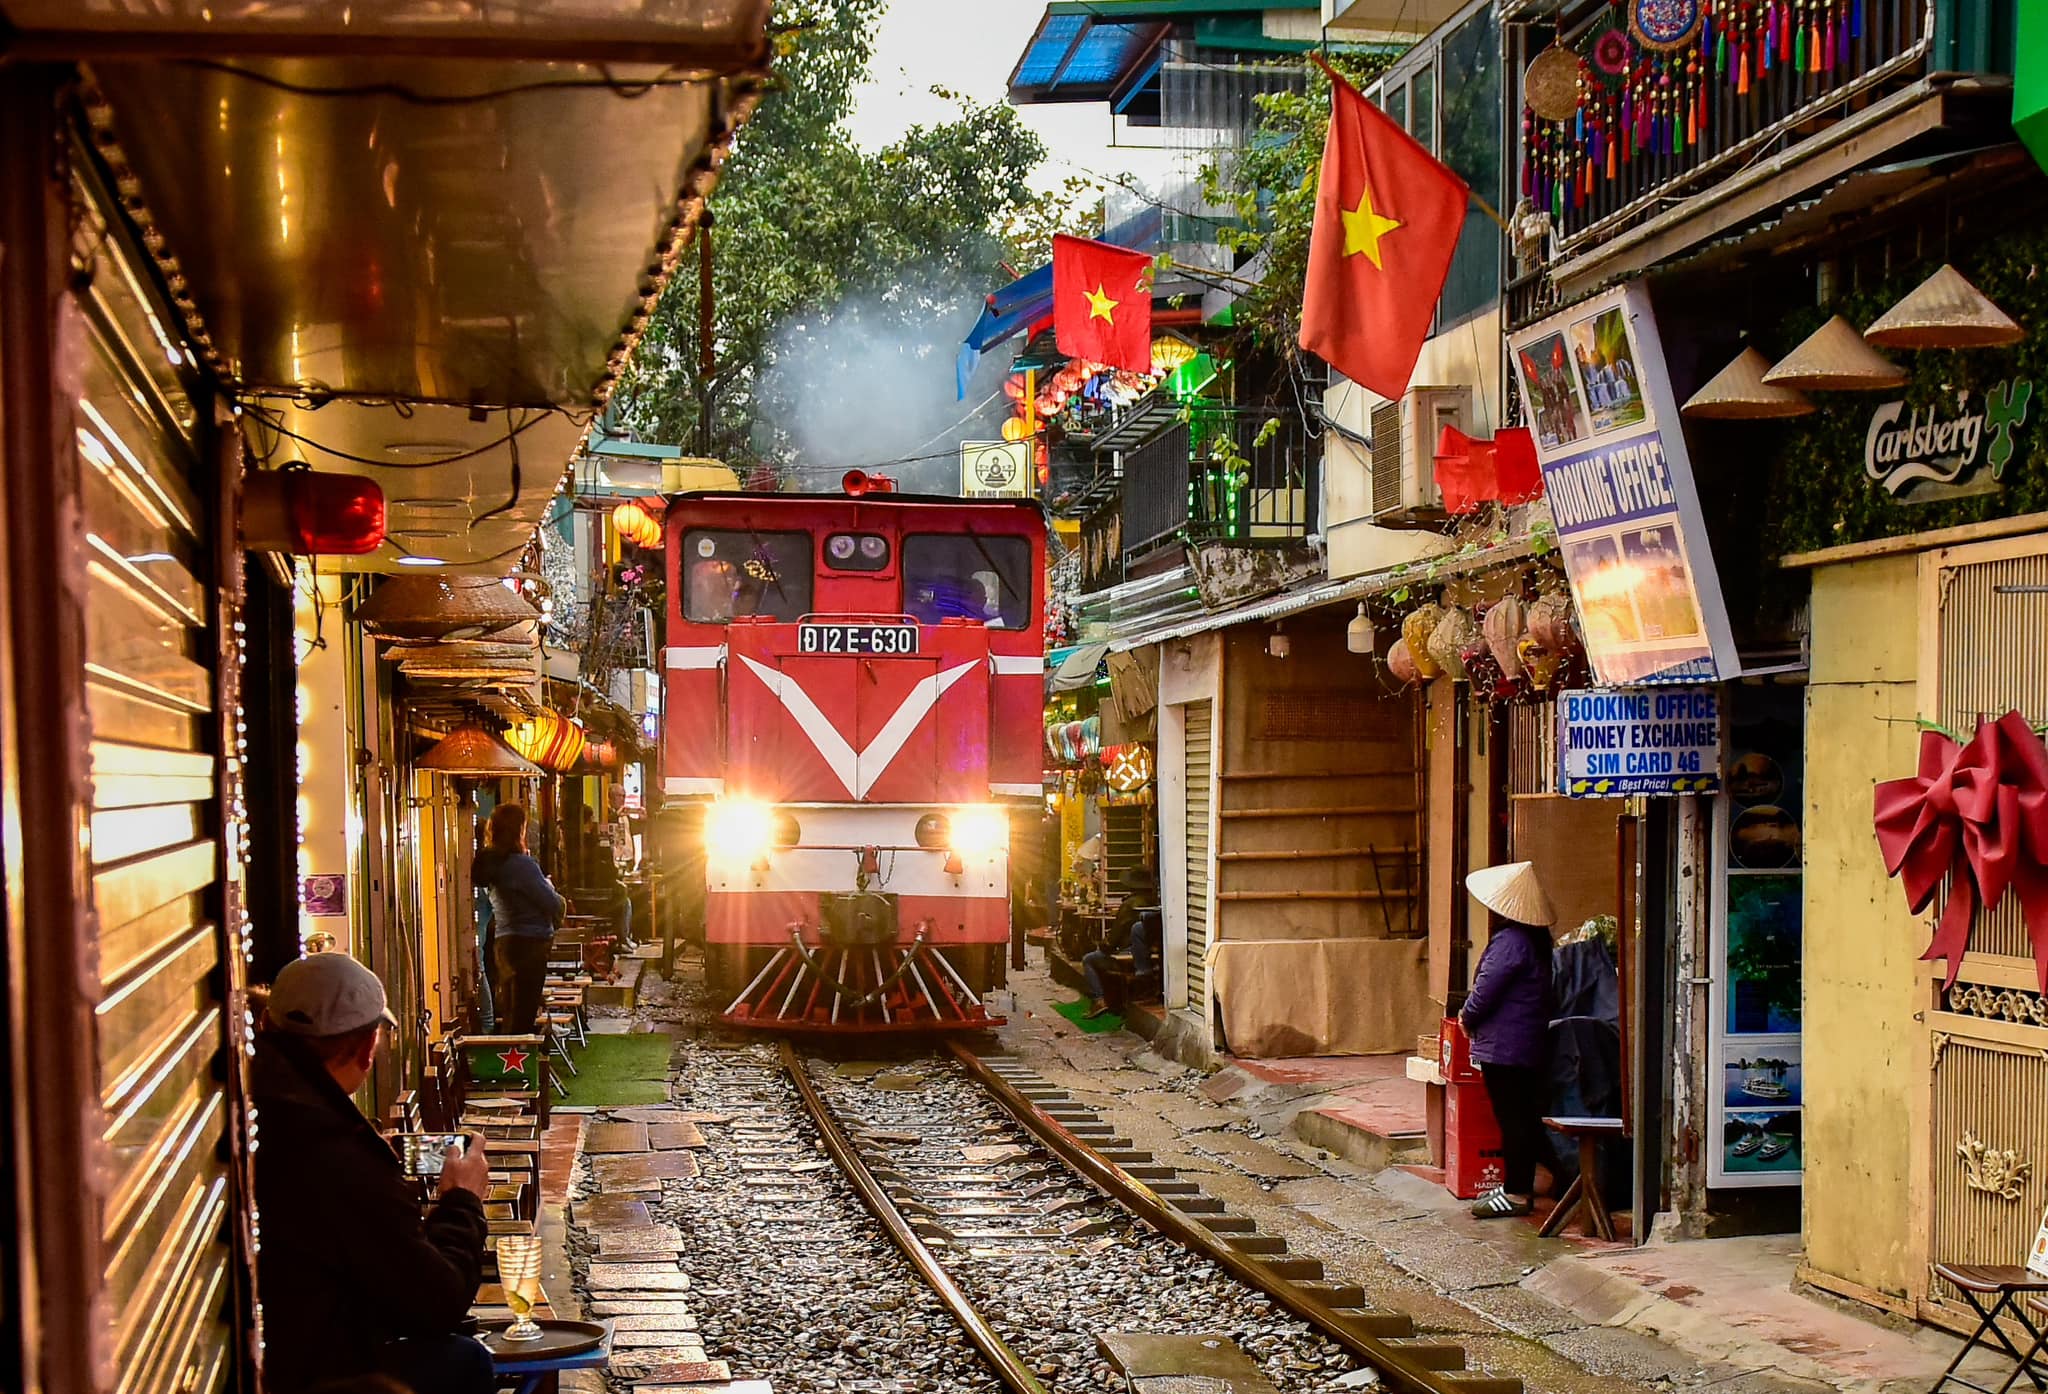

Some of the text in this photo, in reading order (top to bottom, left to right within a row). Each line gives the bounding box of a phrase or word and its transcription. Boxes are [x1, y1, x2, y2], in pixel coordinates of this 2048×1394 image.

[1865, 396, 1984, 487] Carlsberg
[1545, 440, 1671, 528] BOOKING OFFICE
[1569, 693, 1716, 721] BOOKING OFFICE
[1569, 722, 1716, 749] MONEY EXCHANGE
[1587, 750, 1700, 775] SIM CARD 4G
[1618, 778, 1670, 791] (Best Price)
